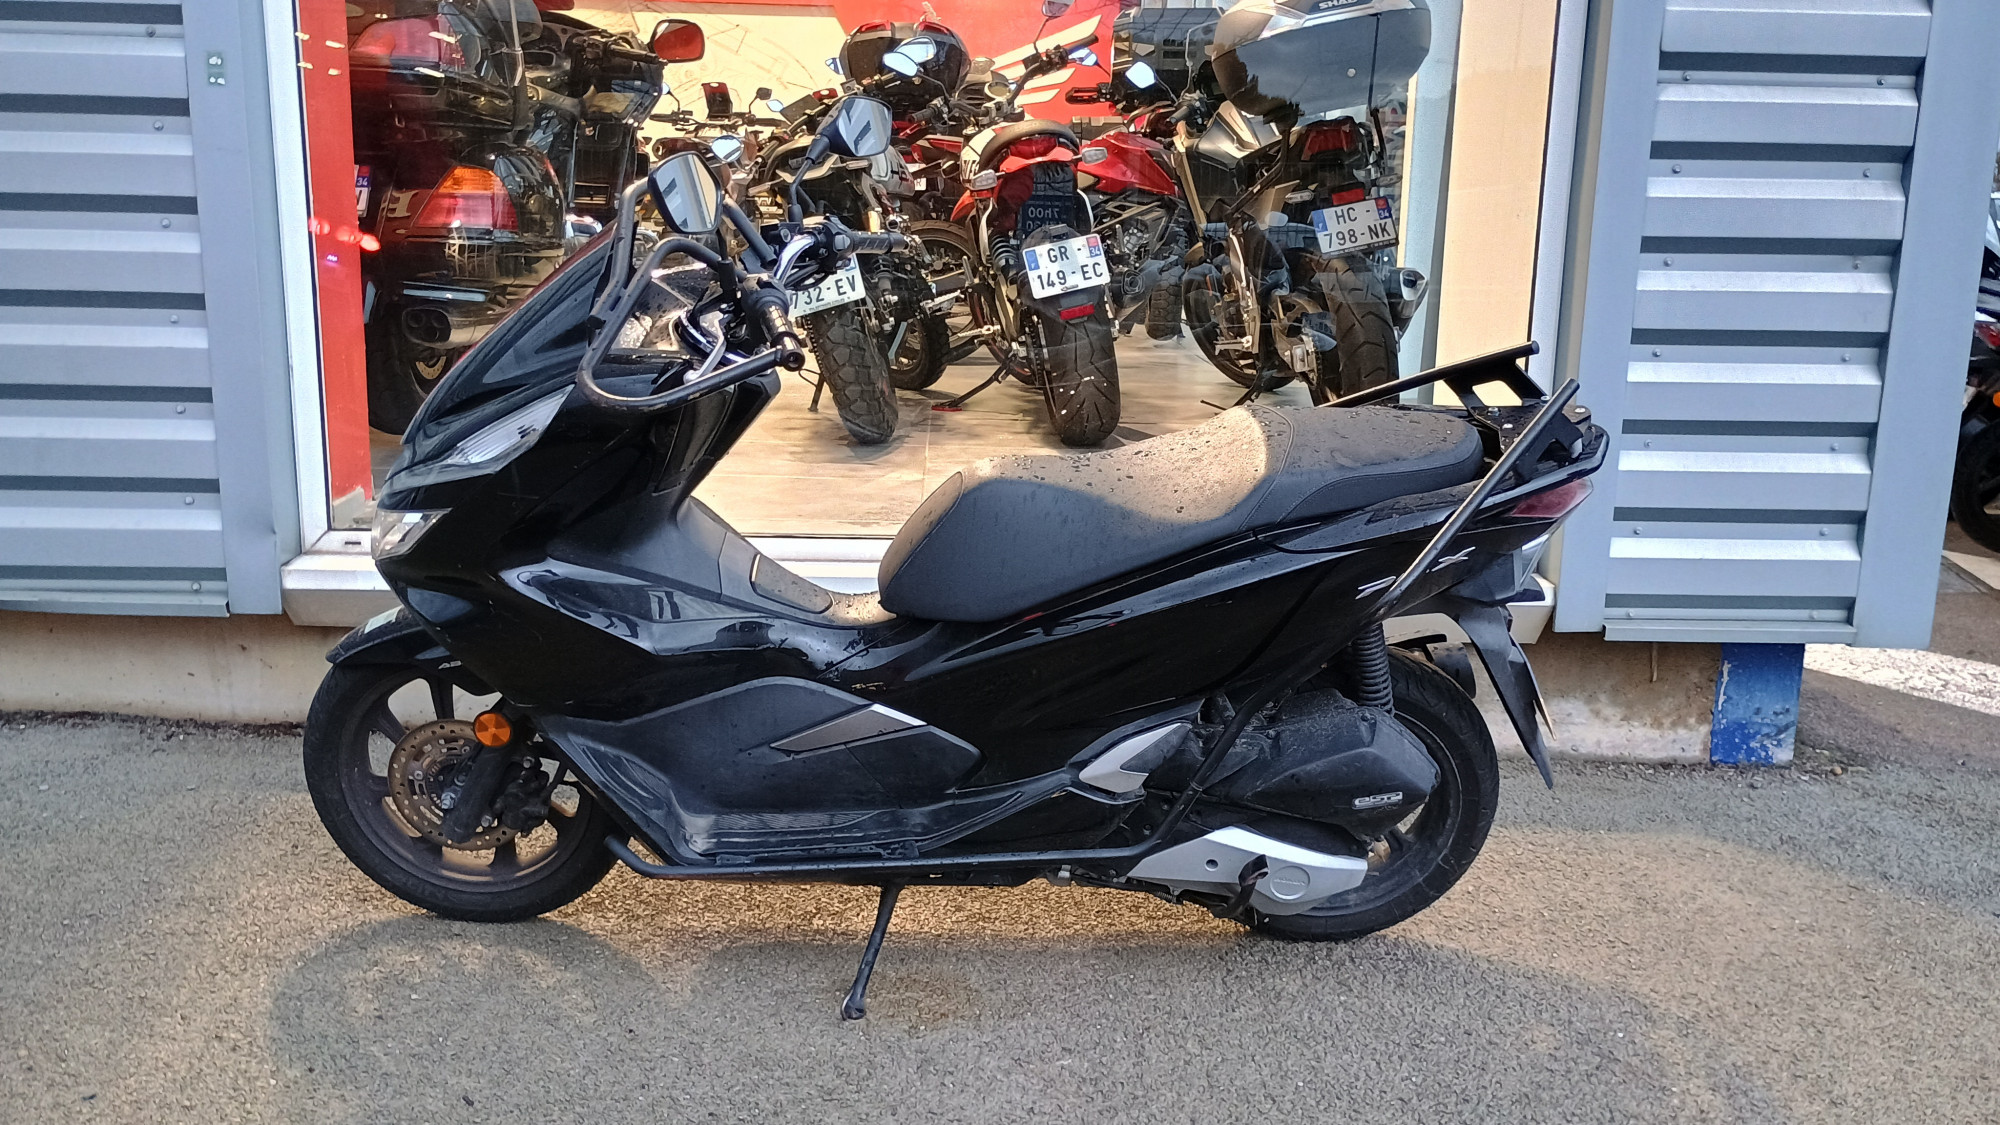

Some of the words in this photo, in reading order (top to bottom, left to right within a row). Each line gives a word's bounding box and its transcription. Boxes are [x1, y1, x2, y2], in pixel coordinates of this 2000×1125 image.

[357, 177, 368, 186] 34
[1334, 206, 1358, 226] HC
[1379, 210, 1390, 218] 34
[1323, 221, 1392, 249] 798-NK
[1047, 245, 1070, 264] GR
[1089, 247, 1100, 256] 34
[1037, 262, 1104, 291] 149-EC
[789, 274, 858, 311] 732-EV
